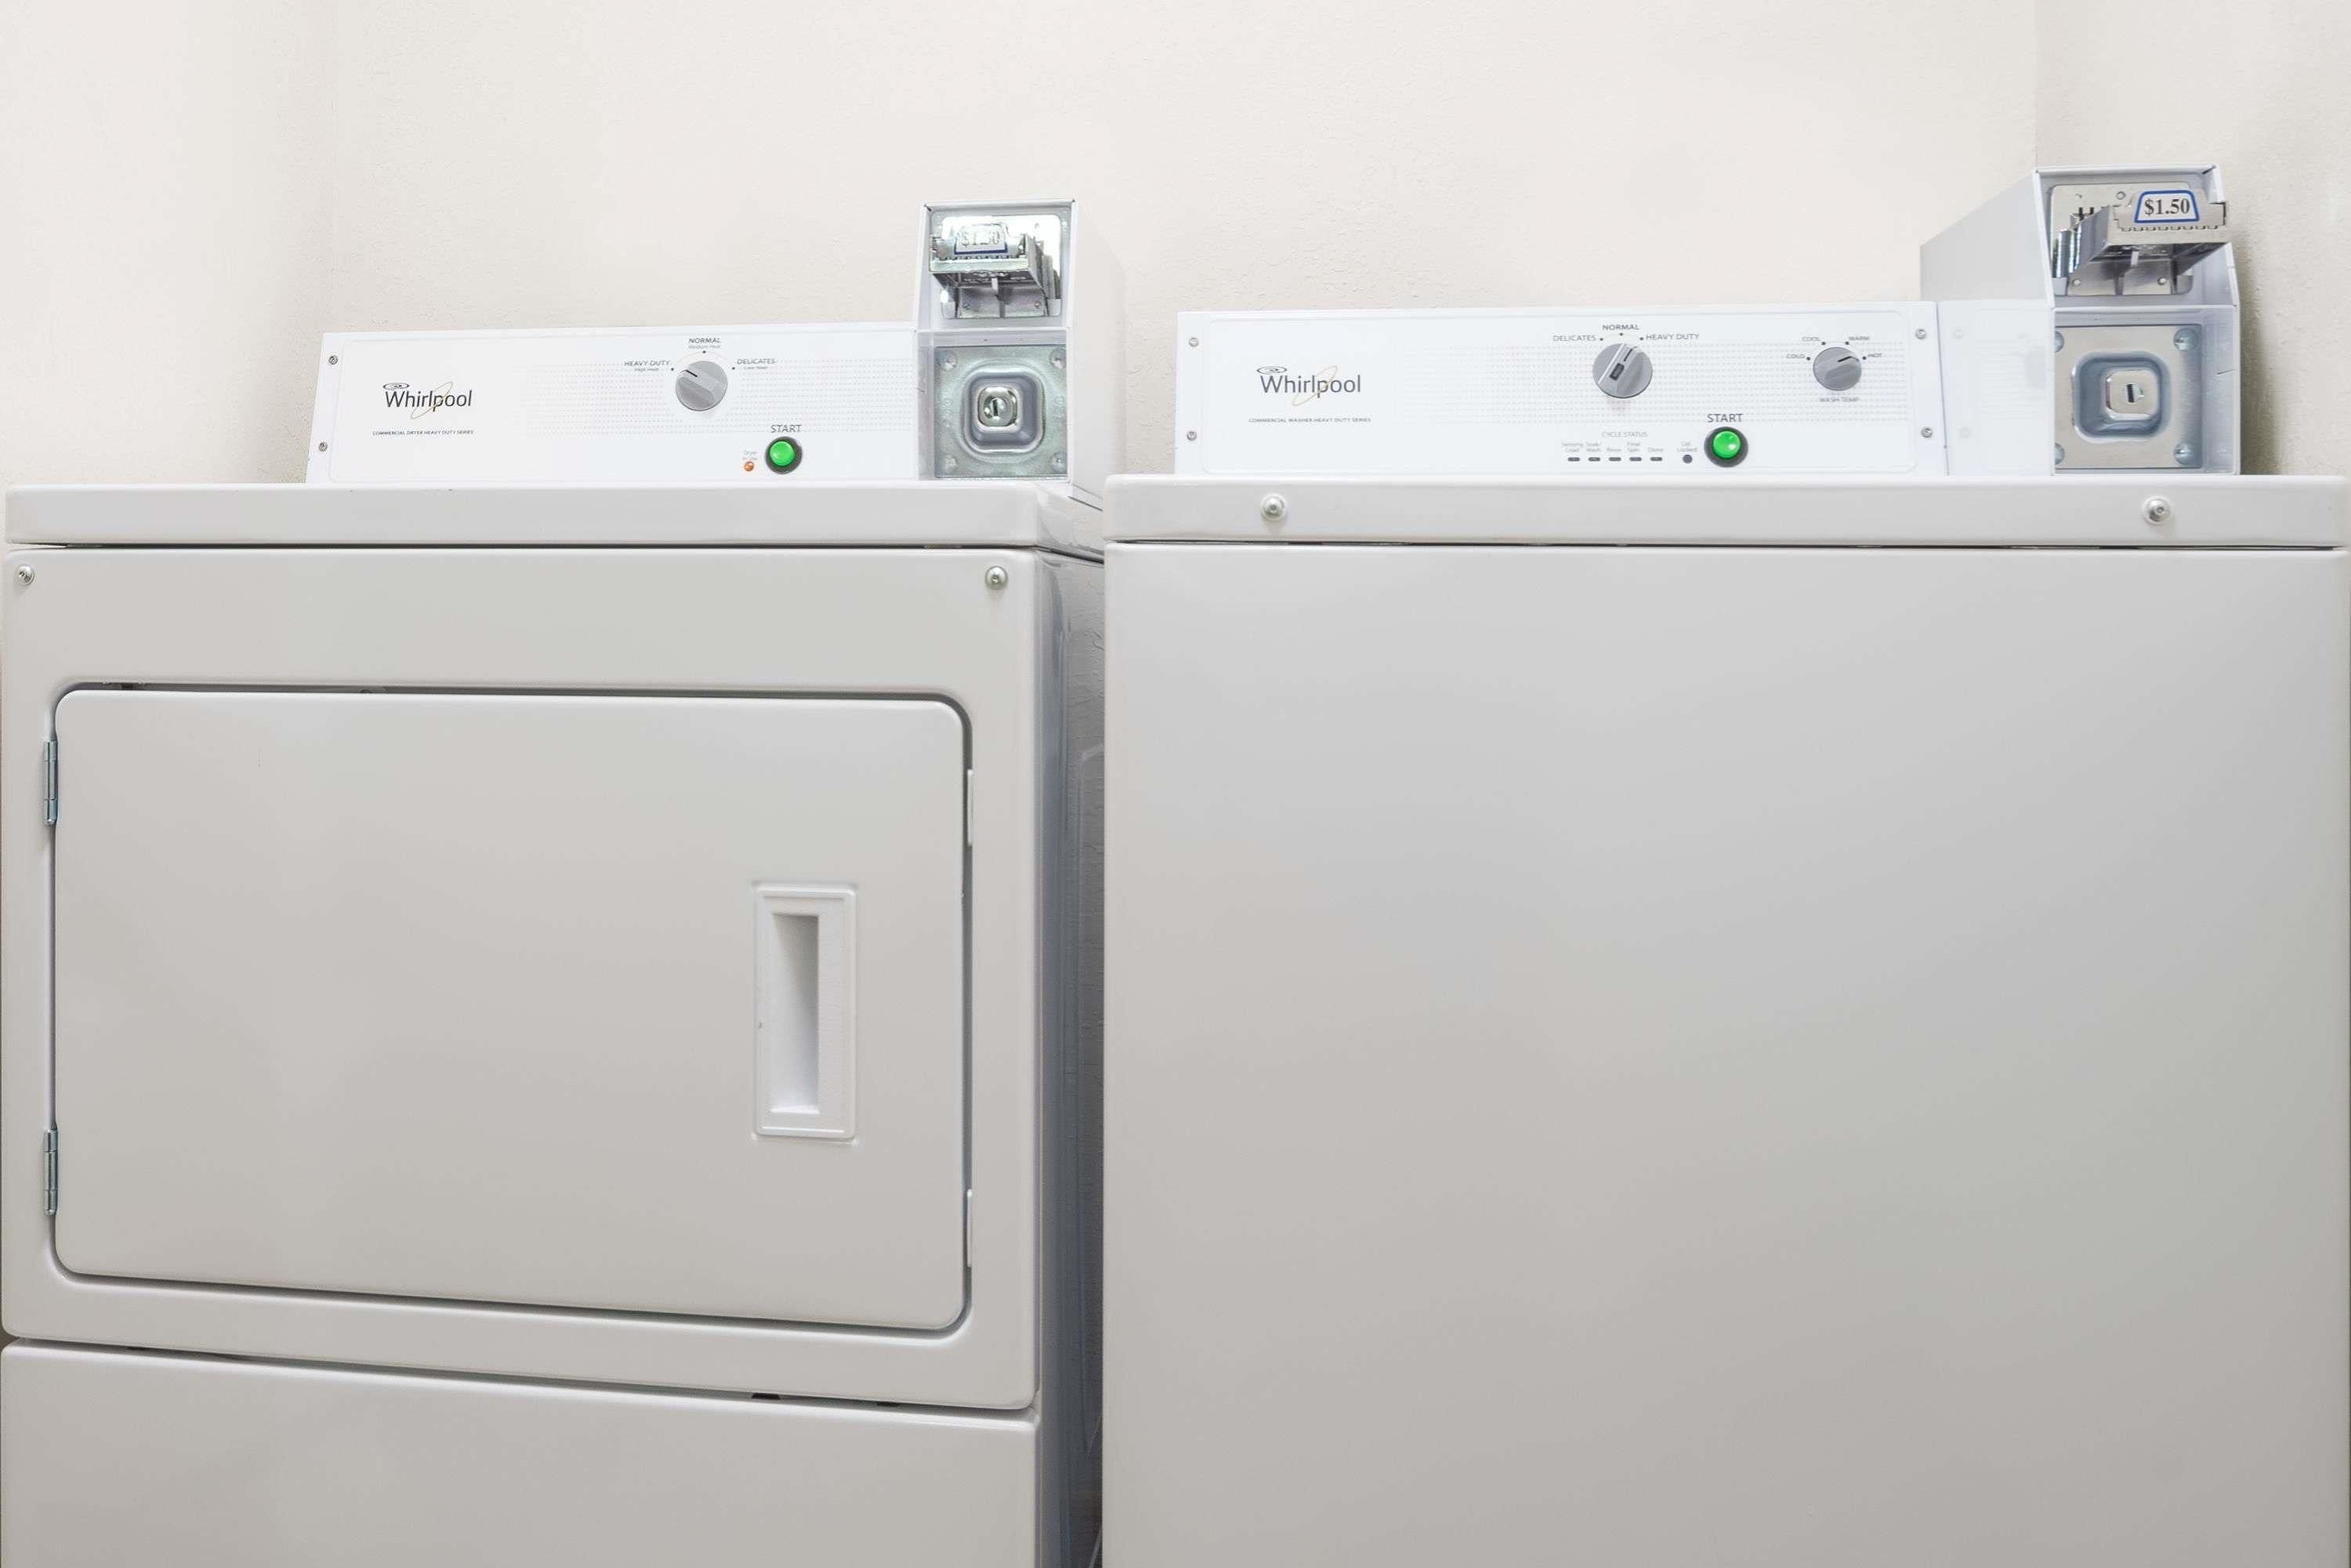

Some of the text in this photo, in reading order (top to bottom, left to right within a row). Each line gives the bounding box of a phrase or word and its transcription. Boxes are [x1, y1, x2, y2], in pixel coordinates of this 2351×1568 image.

[2144, 197, 2190, 217] $1.50
[1259, 375, 1361, 398] Whirlpool
[384, 389, 473, 412] Whirlpool
[1707, 413, 1744, 423] START
[770, 424, 803, 433] START
